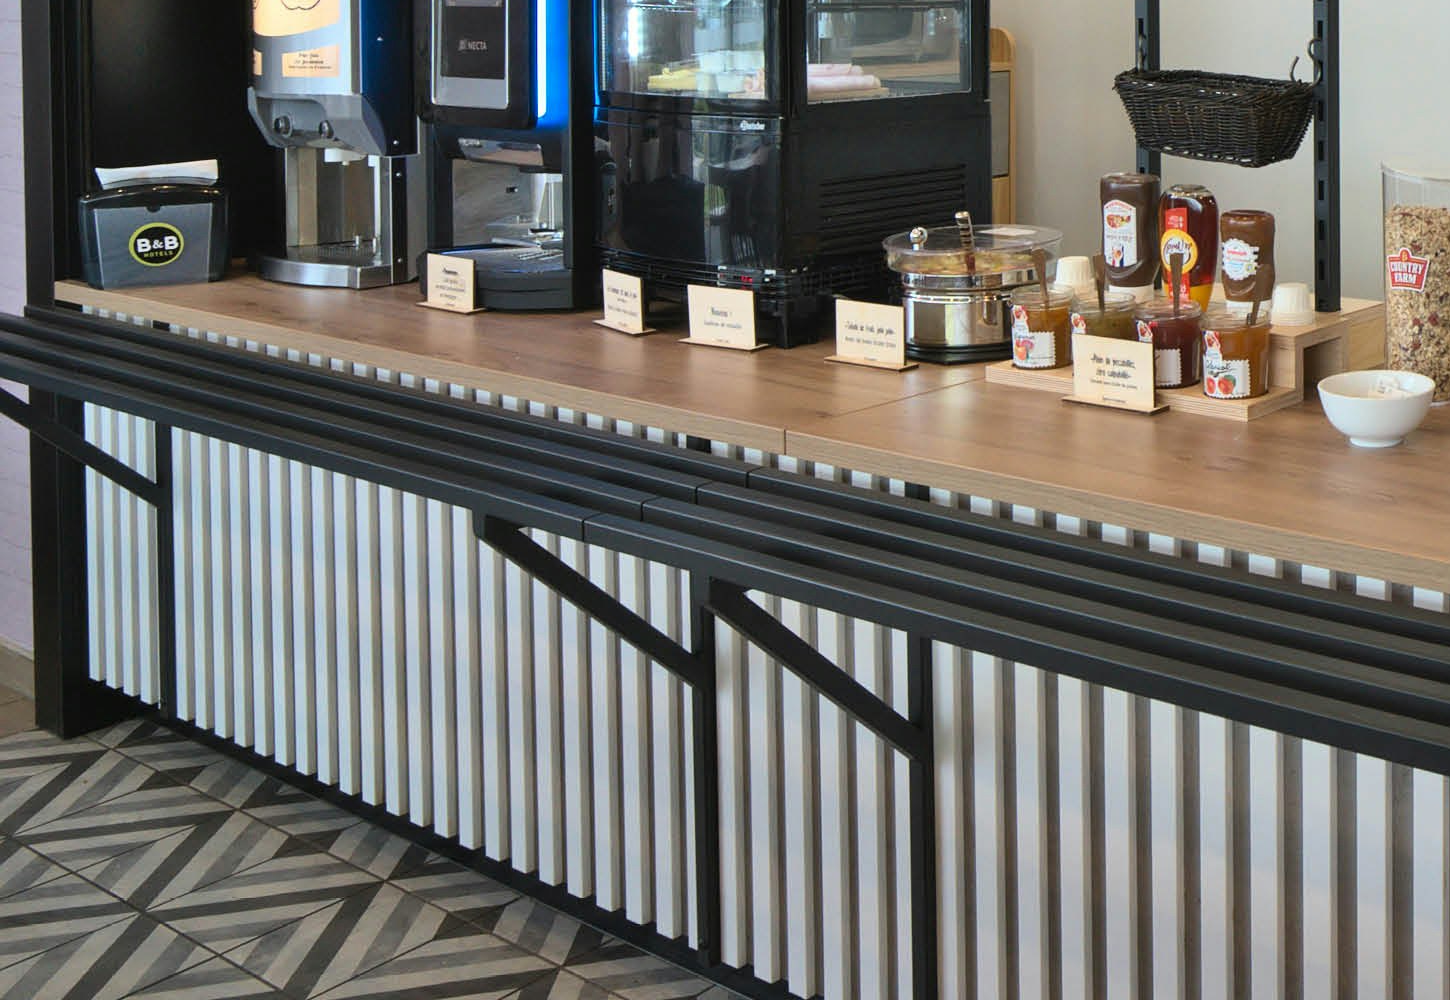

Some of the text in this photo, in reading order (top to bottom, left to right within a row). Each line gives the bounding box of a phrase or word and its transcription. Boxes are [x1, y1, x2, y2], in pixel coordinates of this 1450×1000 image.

[136, 235, 179, 253] B&B
[143, 250, 174, 258] HOTELS
[1394, 272, 1417, 285] FARM
